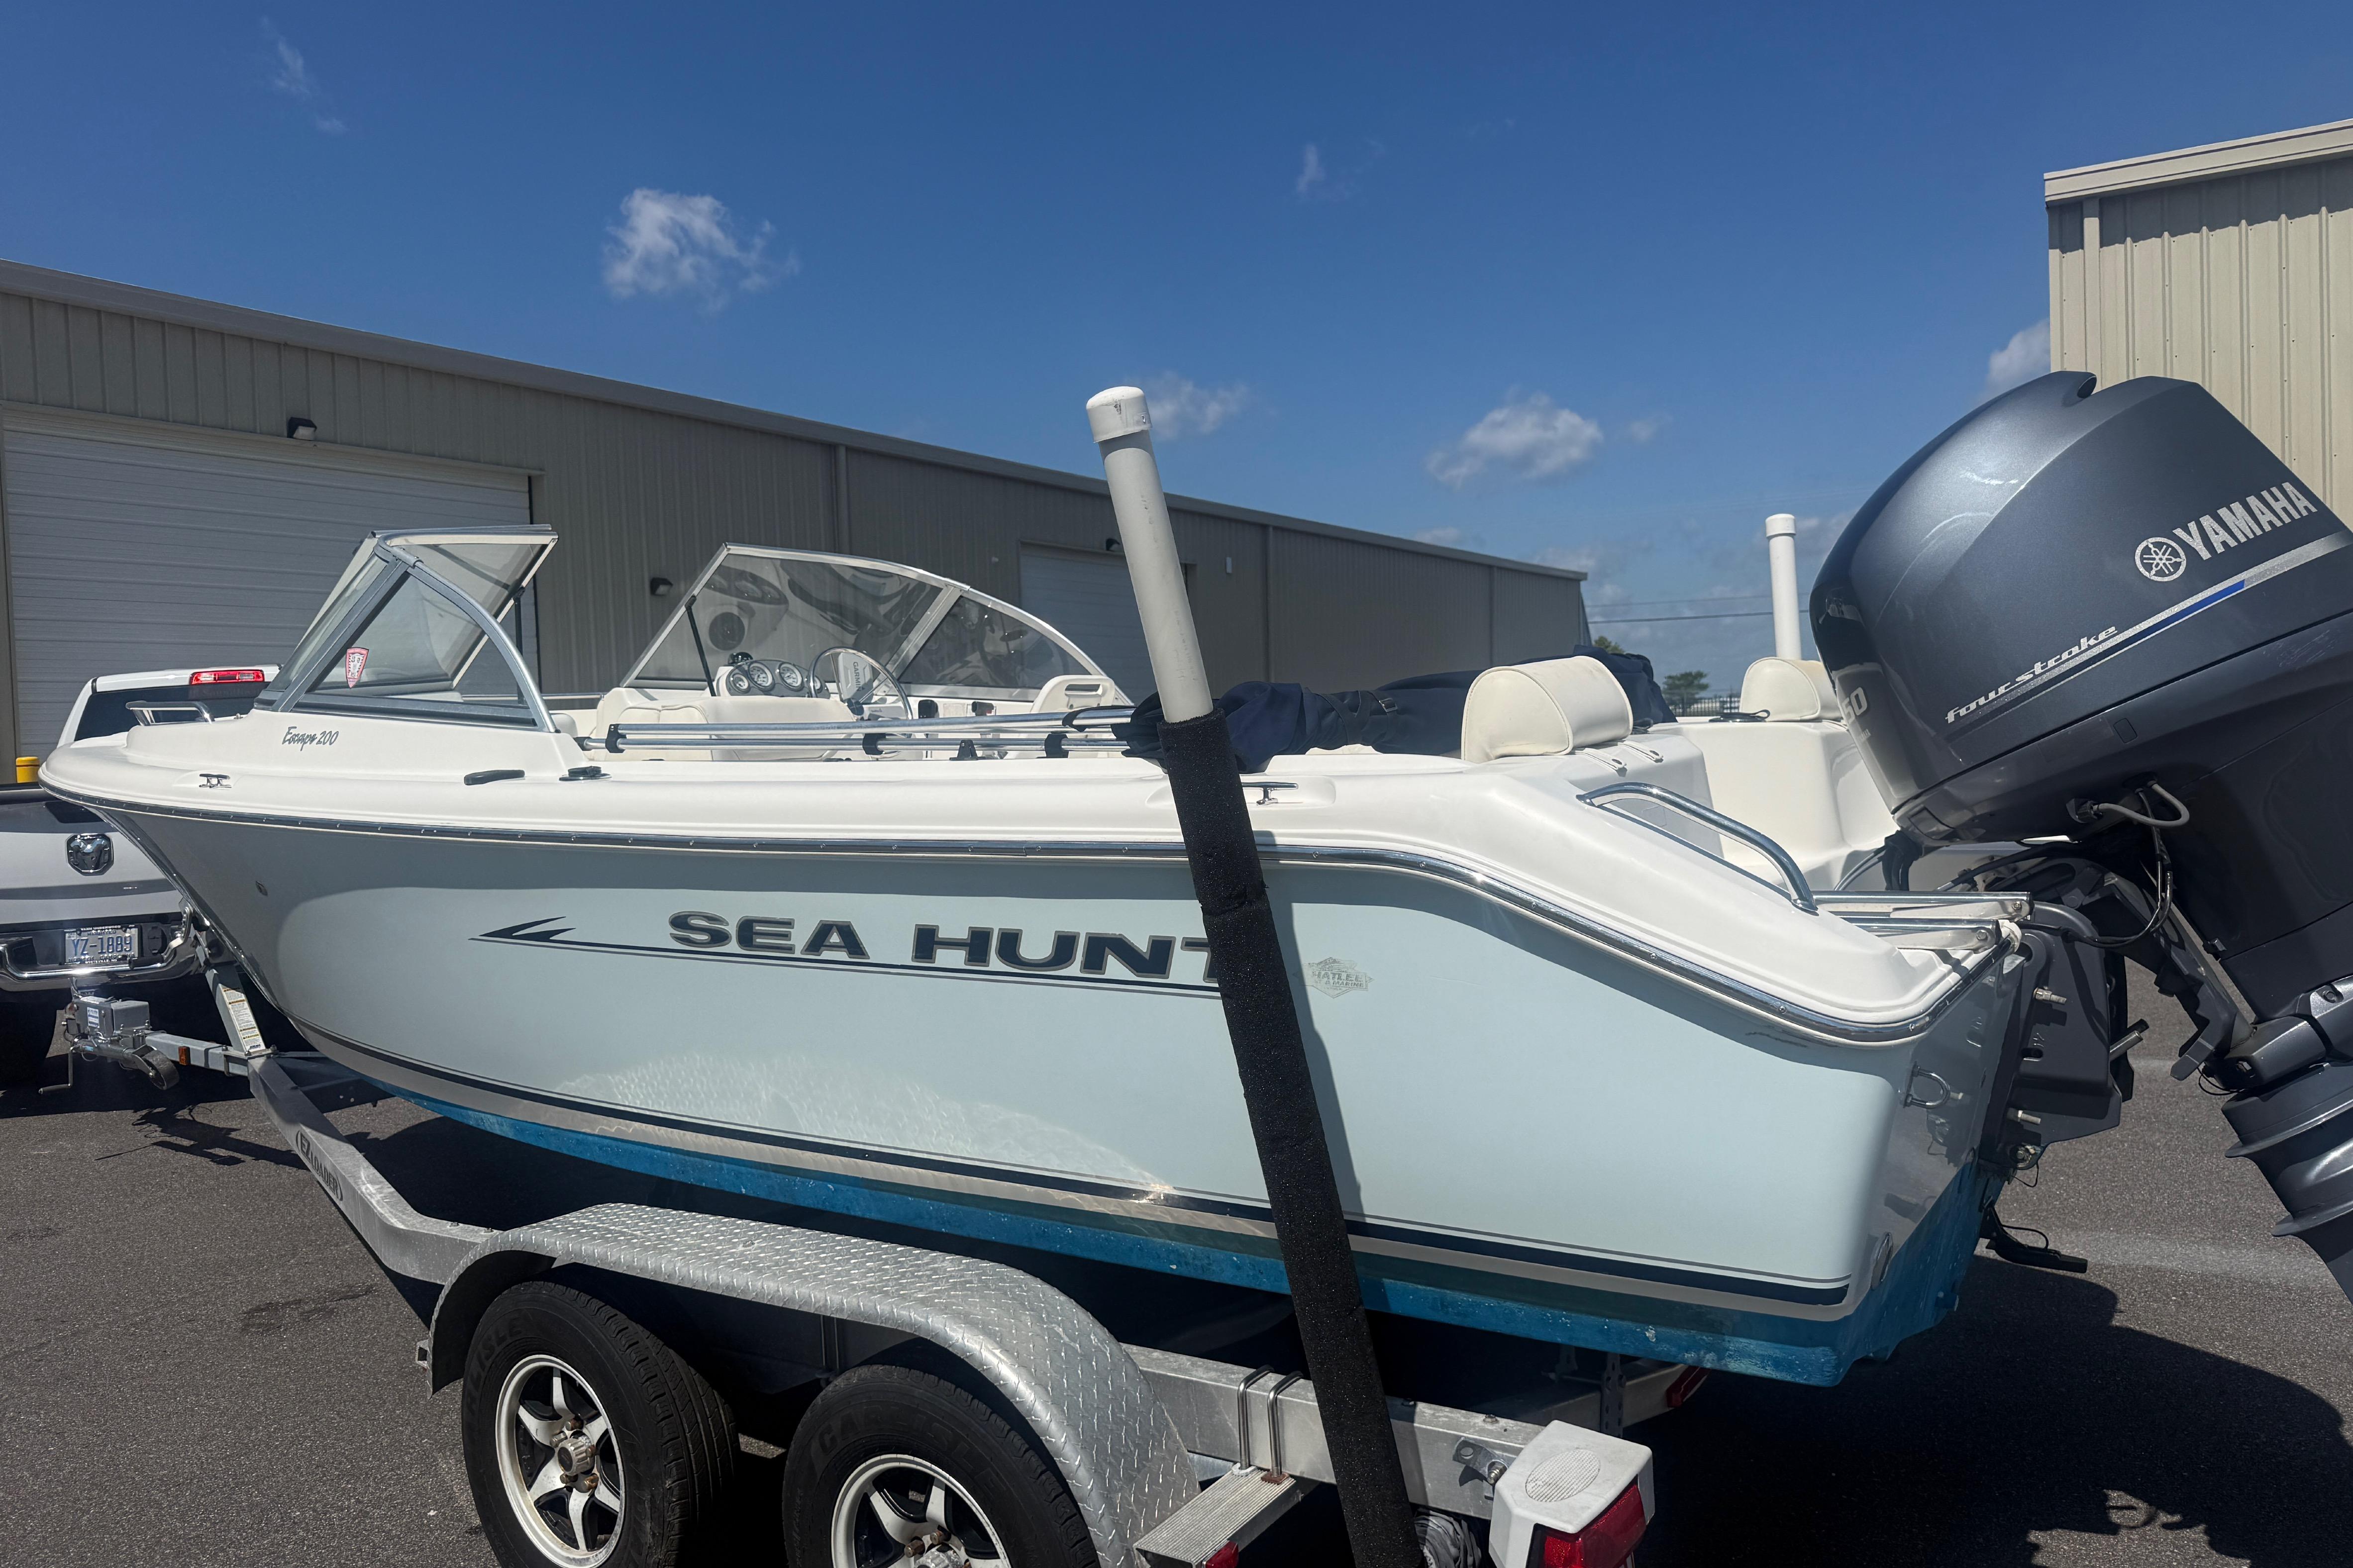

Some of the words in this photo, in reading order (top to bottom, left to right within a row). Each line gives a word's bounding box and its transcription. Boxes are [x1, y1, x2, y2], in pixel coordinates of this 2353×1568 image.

[2172, 482, 2318, 561] YAMAHA
[853, 662, 861, 691] GARMIN
[282, 726, 317, 751] Escape
[316, 730, 339, 745] 200
[72, 936, 132, 956] YZ-1889
[669, 910, 870, 960] SEA
[310, 1151, 338, 1199] LOADER
